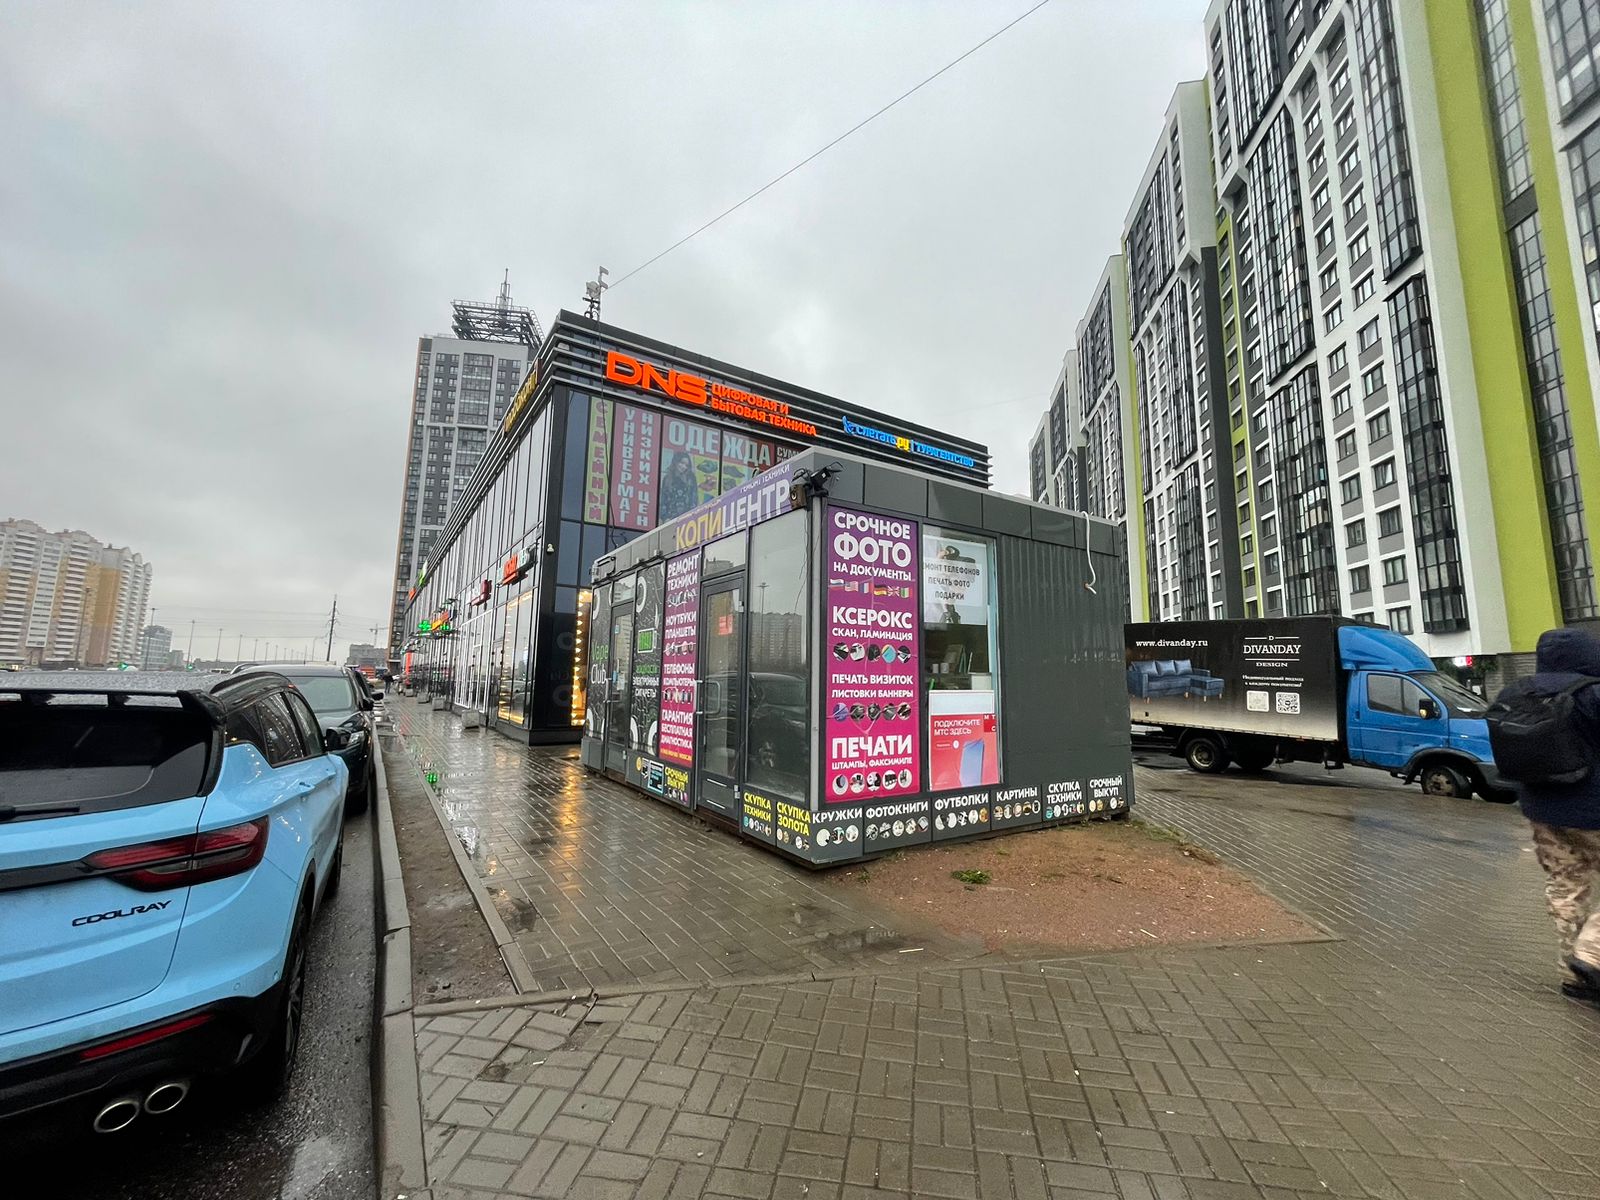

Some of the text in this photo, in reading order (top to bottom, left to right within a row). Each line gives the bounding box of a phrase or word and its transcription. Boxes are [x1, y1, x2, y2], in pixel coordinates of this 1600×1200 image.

[606, 350, 707, 406] DNS
[711, 382, 789, 415] ЦИФРОВАЯ И
[711, 398, 817, 436] БЫТОВАЯ ТЕХНИКА
[668, 420, 771, 466] ОДЕЖДА
[588, 401, 608, 520] СЕМЕЙНЫЙ
[617, 408, 635, 523] УНИВЕРМАГ
[637, 412, 654, 527] НИЗКИХ ЦЕН
[676, 479, 790, 551] КОПИЦЕНТР
[834, 511, 912, 540] СРОЧНОЕ
[833, 531, 912, 568] ФОТО
[667, 554, 698, 576] РЕМОНТ
[833, 561, 912, 581] НА ДОКУМЕНТЫ
[944, 564, 981, 577] ТЕЛЕФОНОВ
[666, 572, 698, 590] ТЕХНИКИ
[928, 576, 971, 588] ПЕЧАТЬ ФОТО
[934, 591, 965, 601] ПОДАРКИ
[665, 611, 697, 626] НОУТБУКИ
[832, 605, 913, 630] КСЕРОКС
[664, 625, 696, 639] ПЛАНШЕТЫ
[832, 627, 913, 641] СКАН, ЛАМИНАЦИЯ
[592, 642, 609, 661] Vape
[1136, 638, 1208, 649] www.divanday.ru
[1243, 644, 1301, 655] DIVANDAY
[591, 663, 607, 684] Club
[663, 663, 695, 675] ТЕЛЕФОНЫ
[832, 673, 914, 686] ПЕЧАТЬ ВИЗИТОК
[831, 689, 914, 699] ЛИСТОВКИ БАННЕРЫ
[662, 709, 693, 725] ГАРАНТИЯ
[934, 719, 981, 728] ПОДКЛЮЧИТЕ
[934, 728, 972, 736] МТС ЗДЕСЬ
[832, 734, 912, 759] ПЕЧАТИ
[831, 756, 913, 770] ШТАМПЫ, ФАКСИМИЛЕ
[1048, 780, 1081, 793] СКУПКА
[1089, 775, 1123, 789] СРОЧНЫЙ
[743, 792, 771, 810] СКУПКА
[996, 787, 1038, 802] КАРТИНЫ
[1046, 790, 1082, 805] ТЕХНИКИ
[1094, 787, 1119, 798] ВЫКУП
[865, 801, 929, 819] ФОТОКНИГИ
[934, 793, 989, 811] ФУТБОЛКИ
[743, 805, 771, 822] ТЕХНИКИ
[777, 801, 811, 824] СКУПКА
[812, 808, 863, 825] КРУЖКИ
[777, 815, 810, 836] ЗОЛОТА
[72, 900, 172, 927] COOLRAY
